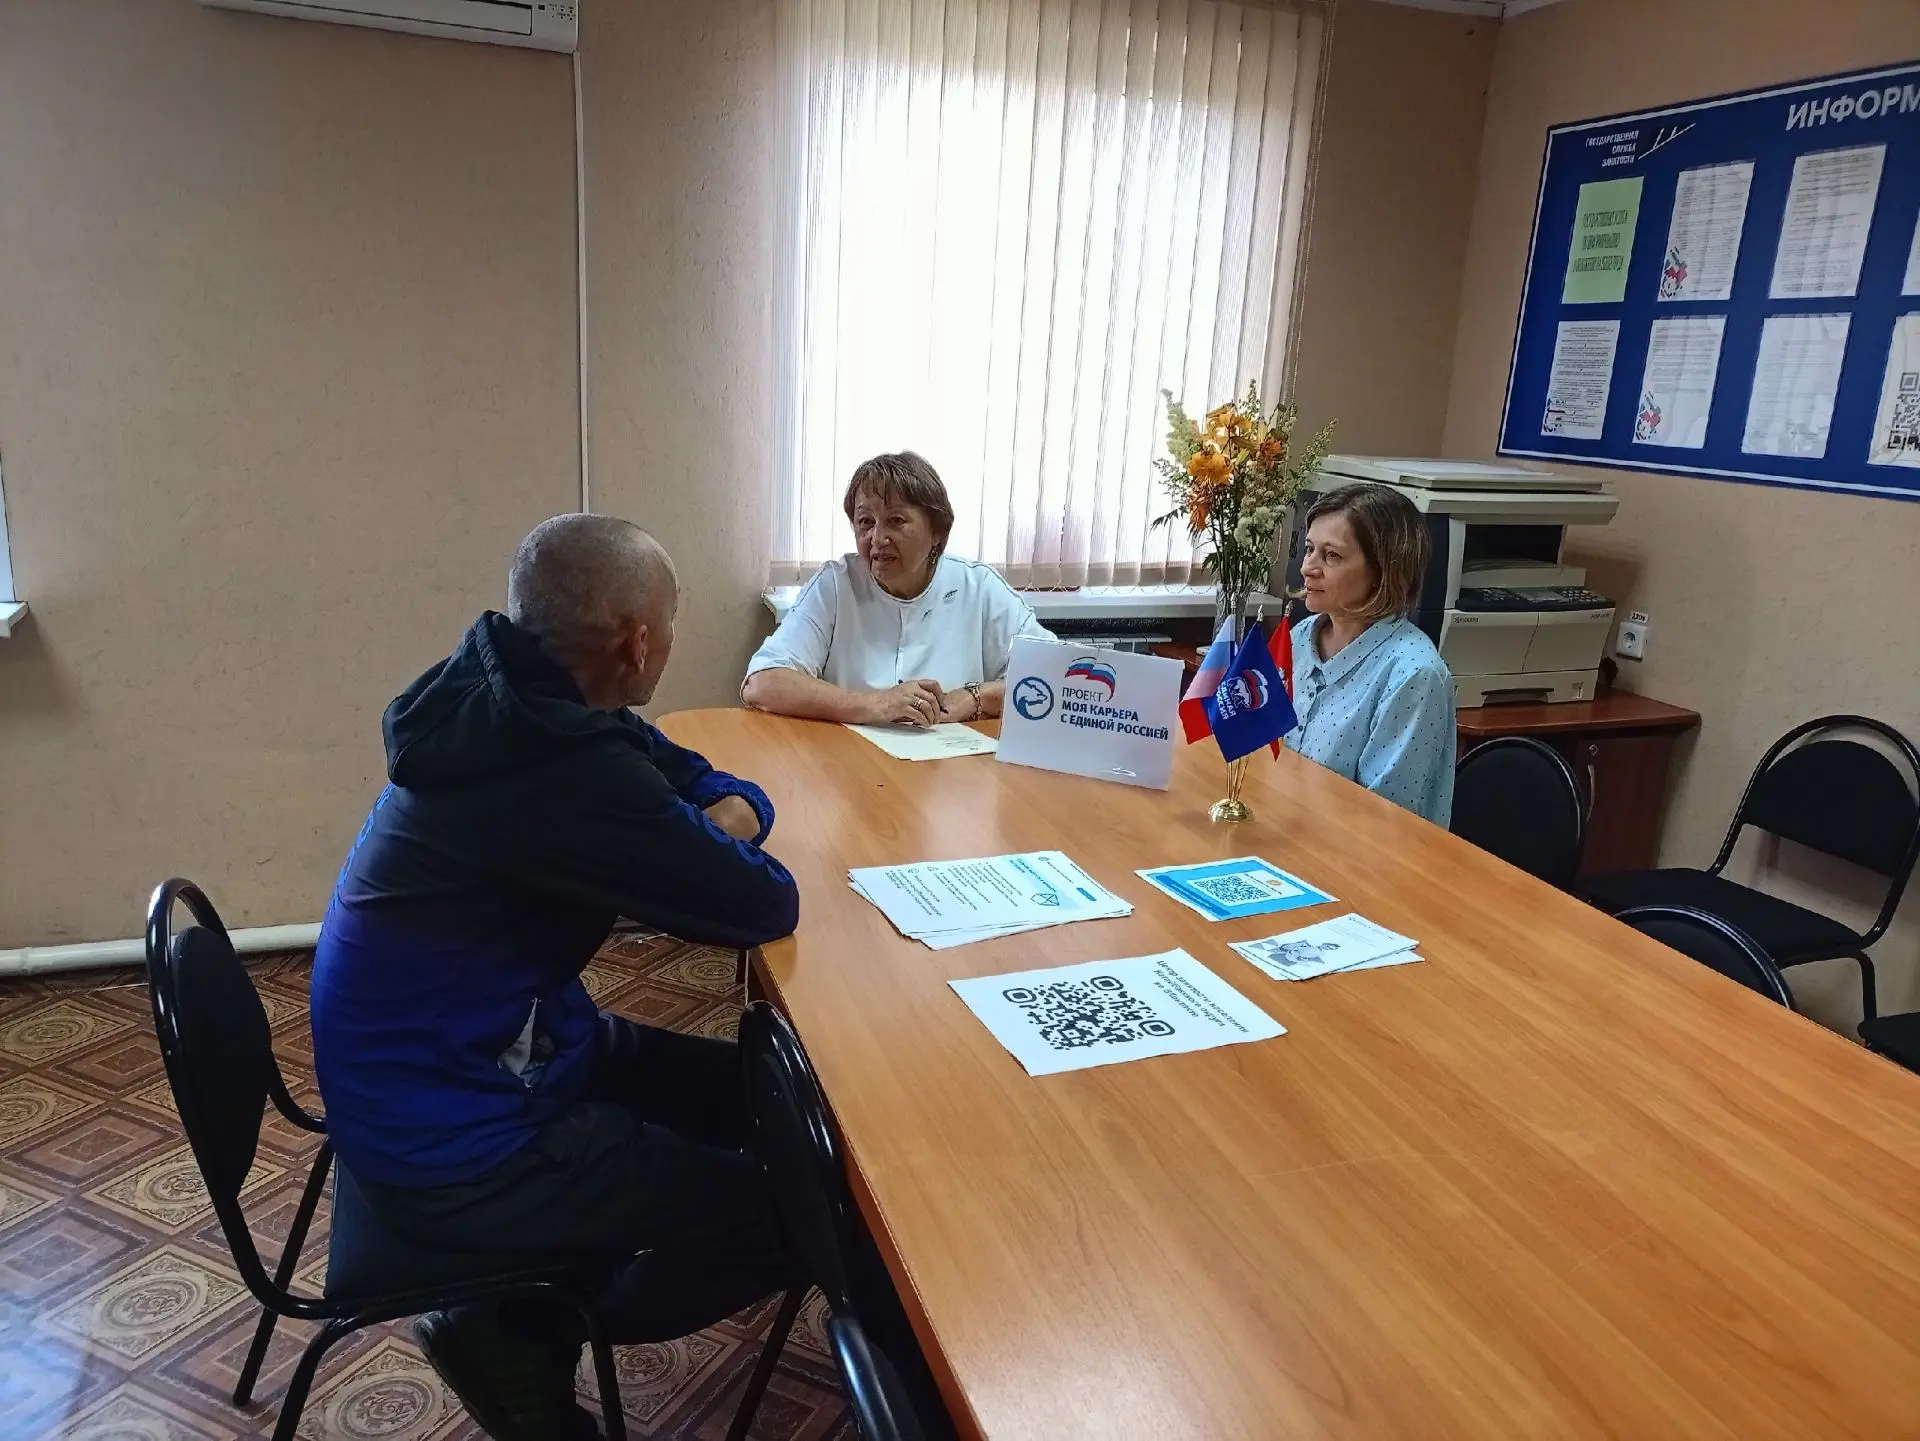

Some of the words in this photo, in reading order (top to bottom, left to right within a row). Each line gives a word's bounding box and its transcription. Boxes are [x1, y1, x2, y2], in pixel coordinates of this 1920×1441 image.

[1785, 84, 1920, 131] ИНФОРМ
[1585, 130, 1640, 147] ГОСУДАРСТВЕННАЯ
[1612, 142, 1637, 155] СЛУЖБА
[1602, 154, 1635, 168] ЗАНЯТОСТИ
[1062, 687, 1104, 702] ПРОЕКТ
[1061, 700, 1088, 714] МОЯ
[1089, 704, 1139, 722] КАРЬЕРА
[1060, 713, 1068, 723] С
[1069, 714, 1115, 732] ЕДИНОЙ
[1117, 721, 1169, 740] РОССИЕЙ
[1156, 960, 1178, 977] Центр
[1176, 976, 1212, 1003] занятости
[1210, 1002, 1249, 1033] населения
[1200, 1006, 1226, 1027] округа
